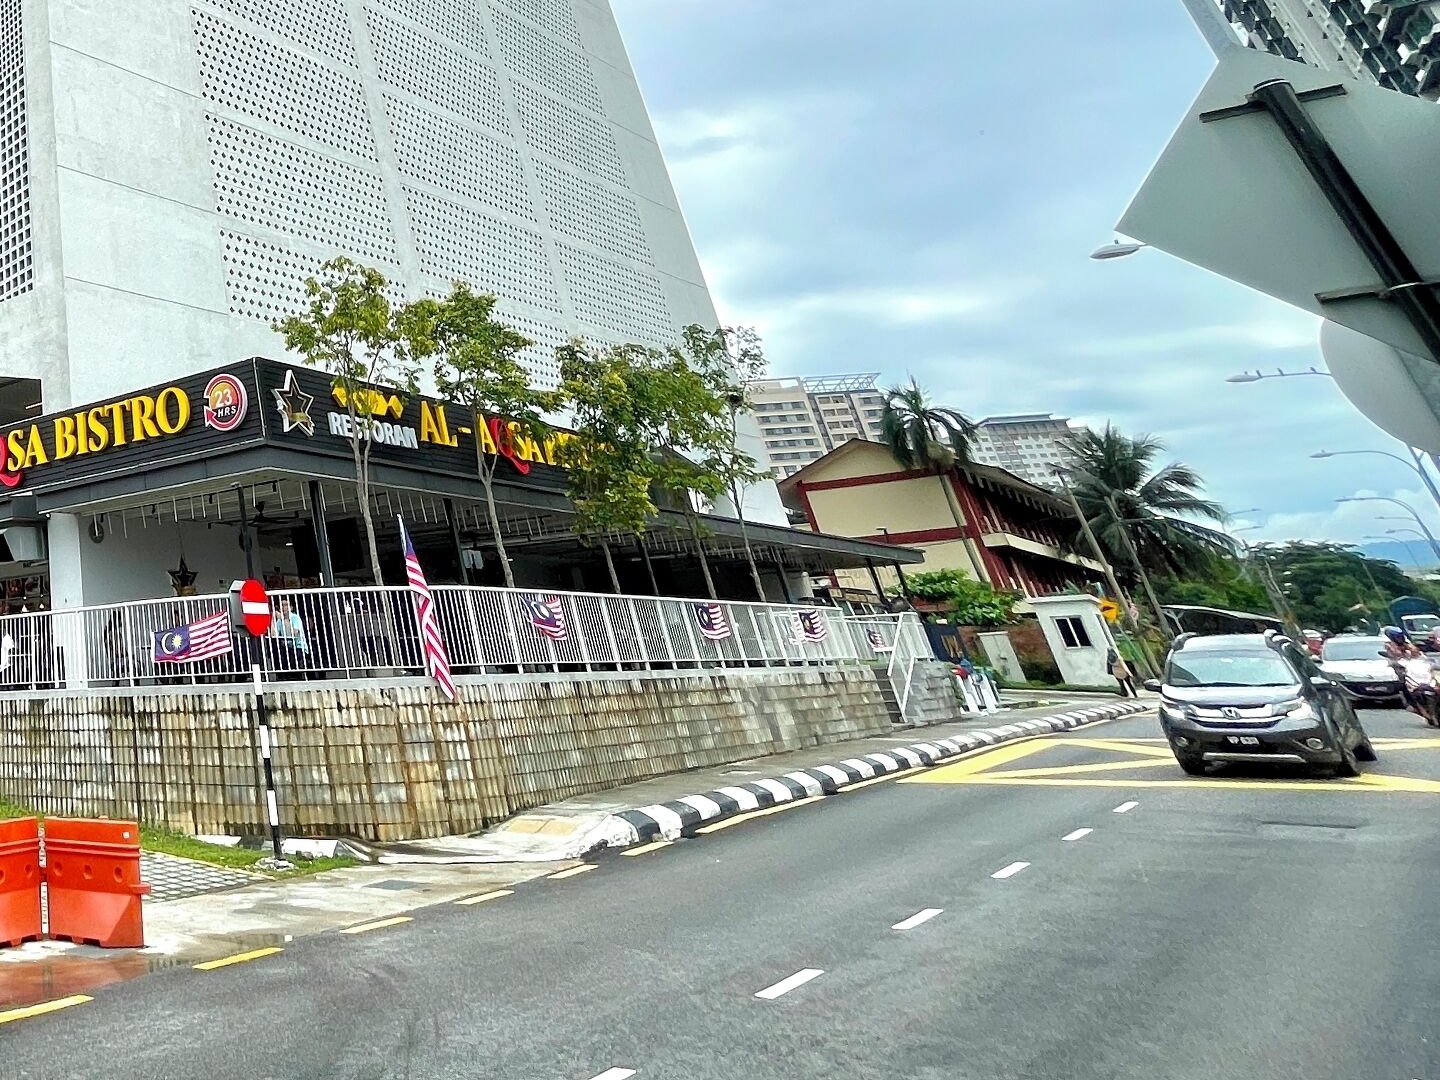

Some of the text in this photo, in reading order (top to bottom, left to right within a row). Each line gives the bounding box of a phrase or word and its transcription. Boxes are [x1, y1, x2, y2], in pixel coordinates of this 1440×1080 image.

[215, 389, 232, 408] 23
[217, 405, 237, 418] HRS
[53, 386, 190, 460] BISTRO
